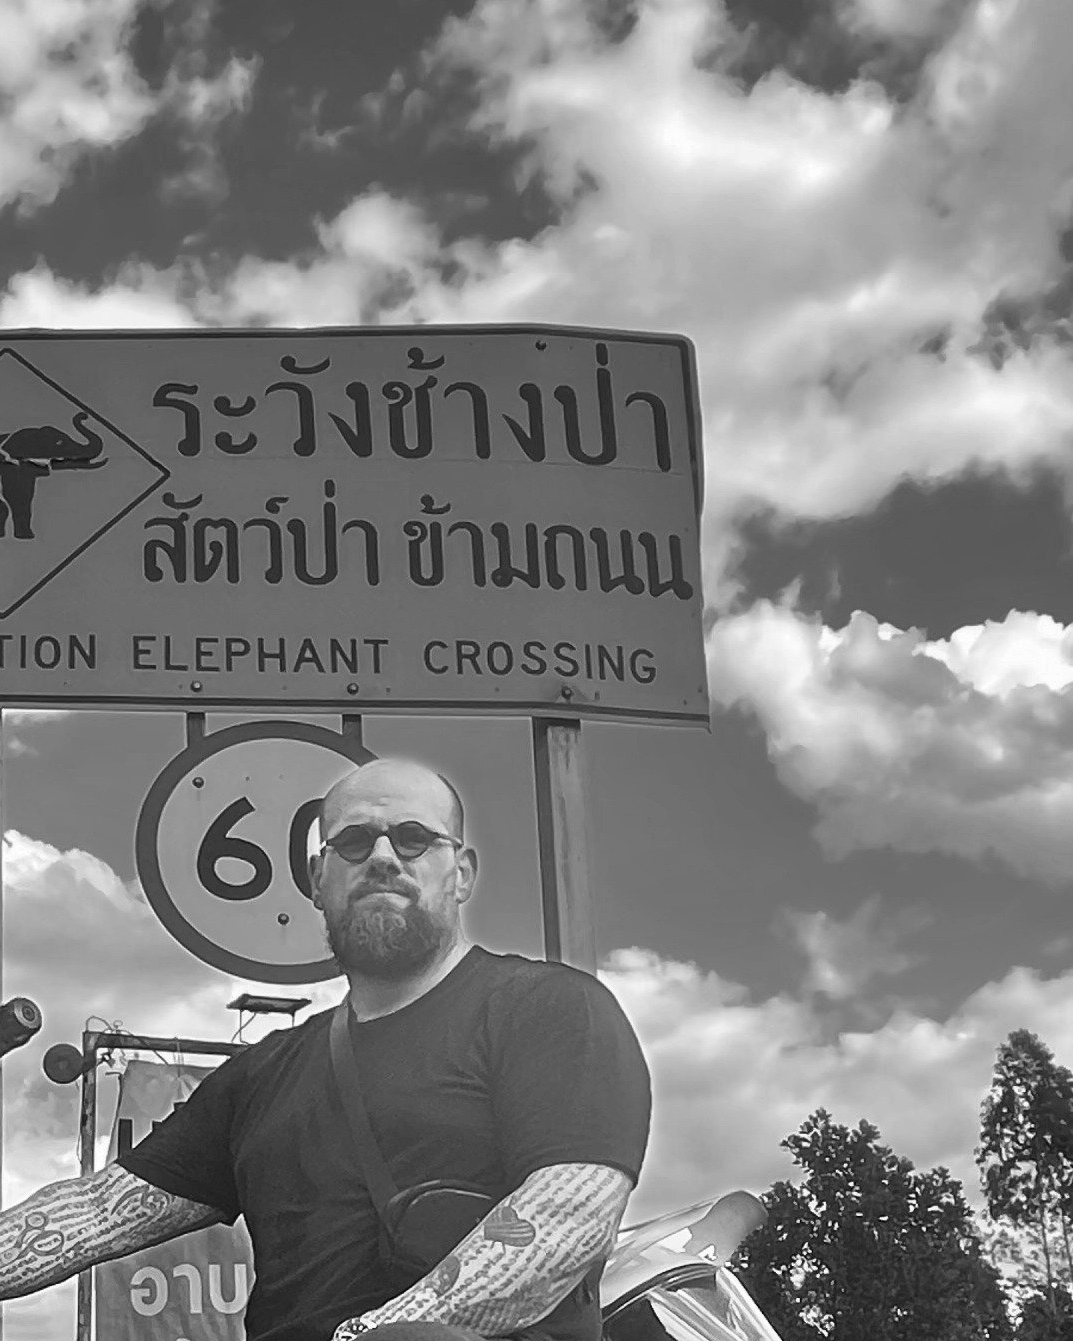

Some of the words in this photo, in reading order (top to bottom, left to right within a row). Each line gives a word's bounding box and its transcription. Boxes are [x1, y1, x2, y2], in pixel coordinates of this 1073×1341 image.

[152, 343, 673, 472] ระวังช้างป่า
[142, 479, 381, 587] สัตว์ป่า
[403, 494, 693, 600] ข้ามถนน
[132, 634, 390, 674] ELEPHANT
[423, 639, 658, 683] CROSSING
